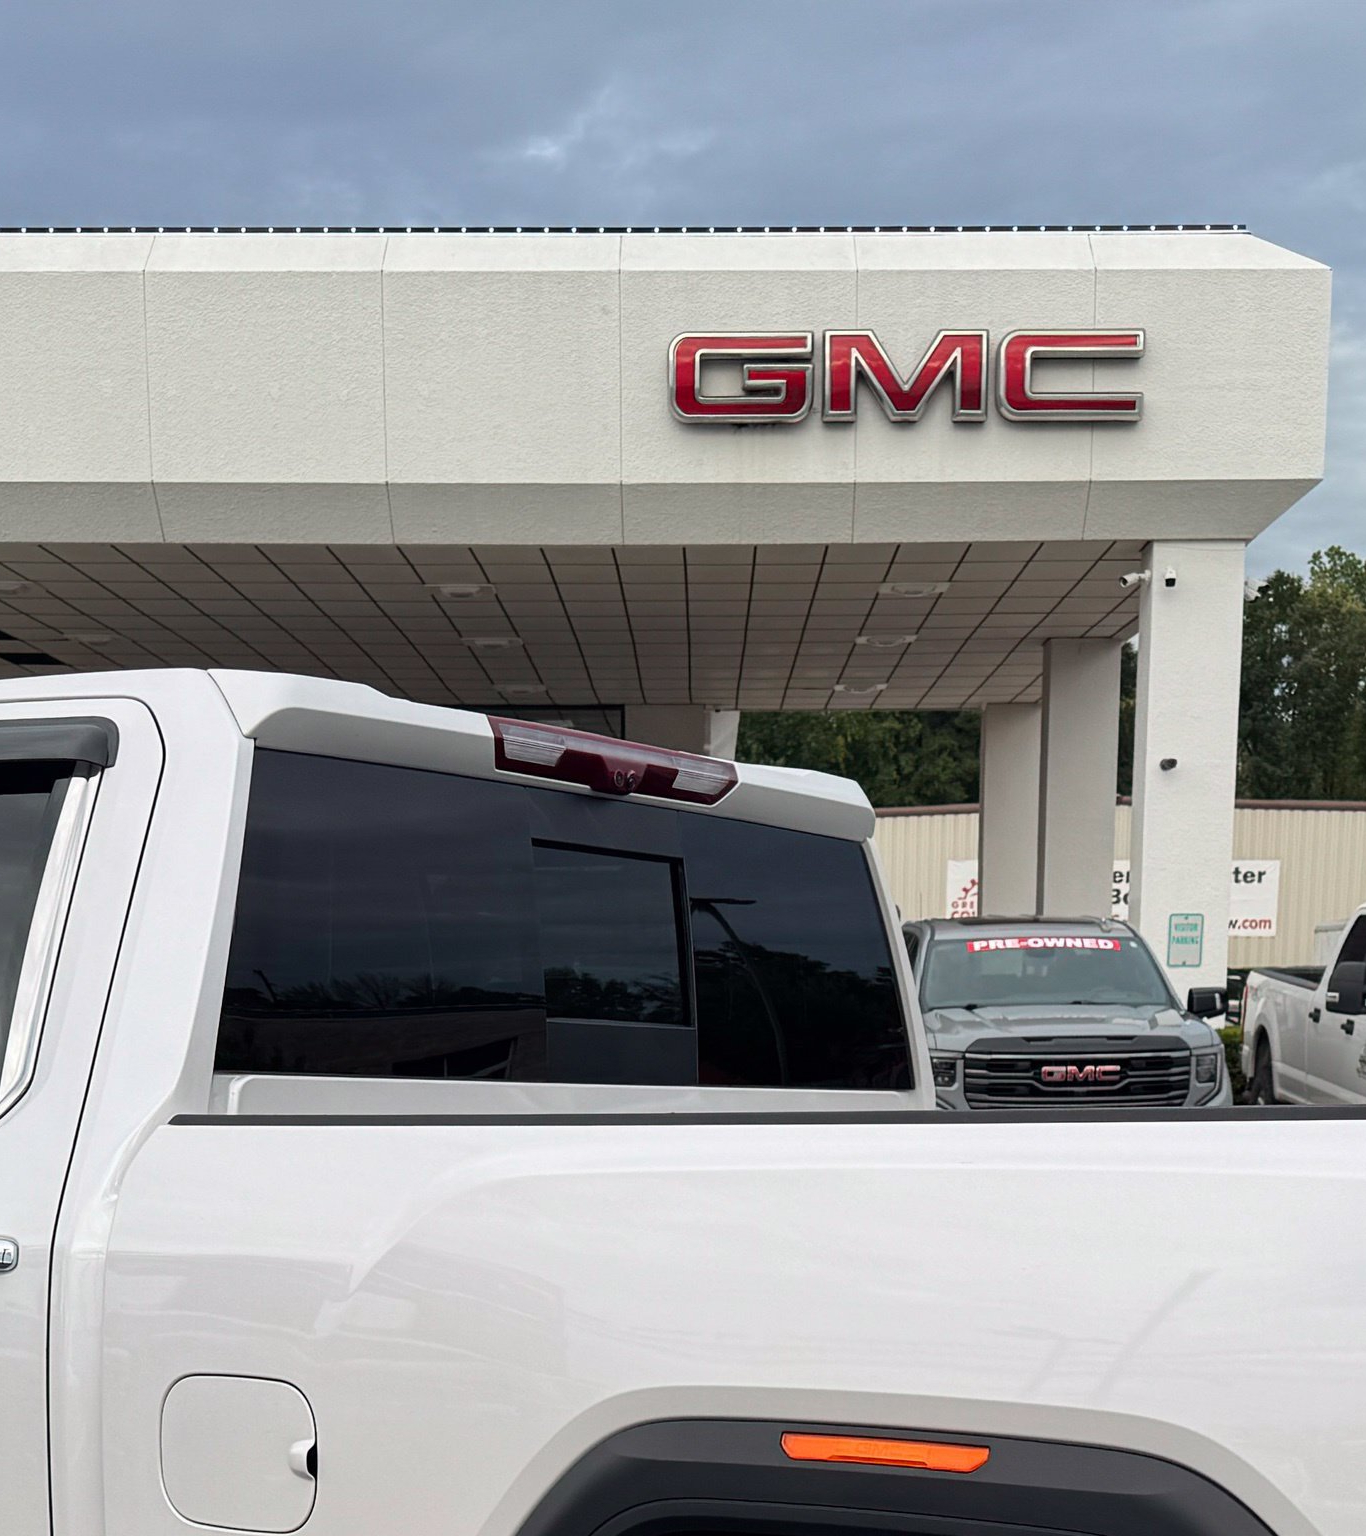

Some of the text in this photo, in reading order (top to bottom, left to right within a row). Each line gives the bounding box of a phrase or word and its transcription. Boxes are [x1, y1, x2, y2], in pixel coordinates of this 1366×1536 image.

[667, 328, 1146, 424] GMC
[1174, 922, 1199, 932] VISITOR
[973, 937, 1114, 951] PRE-OWNED
[1171, 935, 1200, 945] PARKING
[1041, 1065, 1121, 1082] GMC
